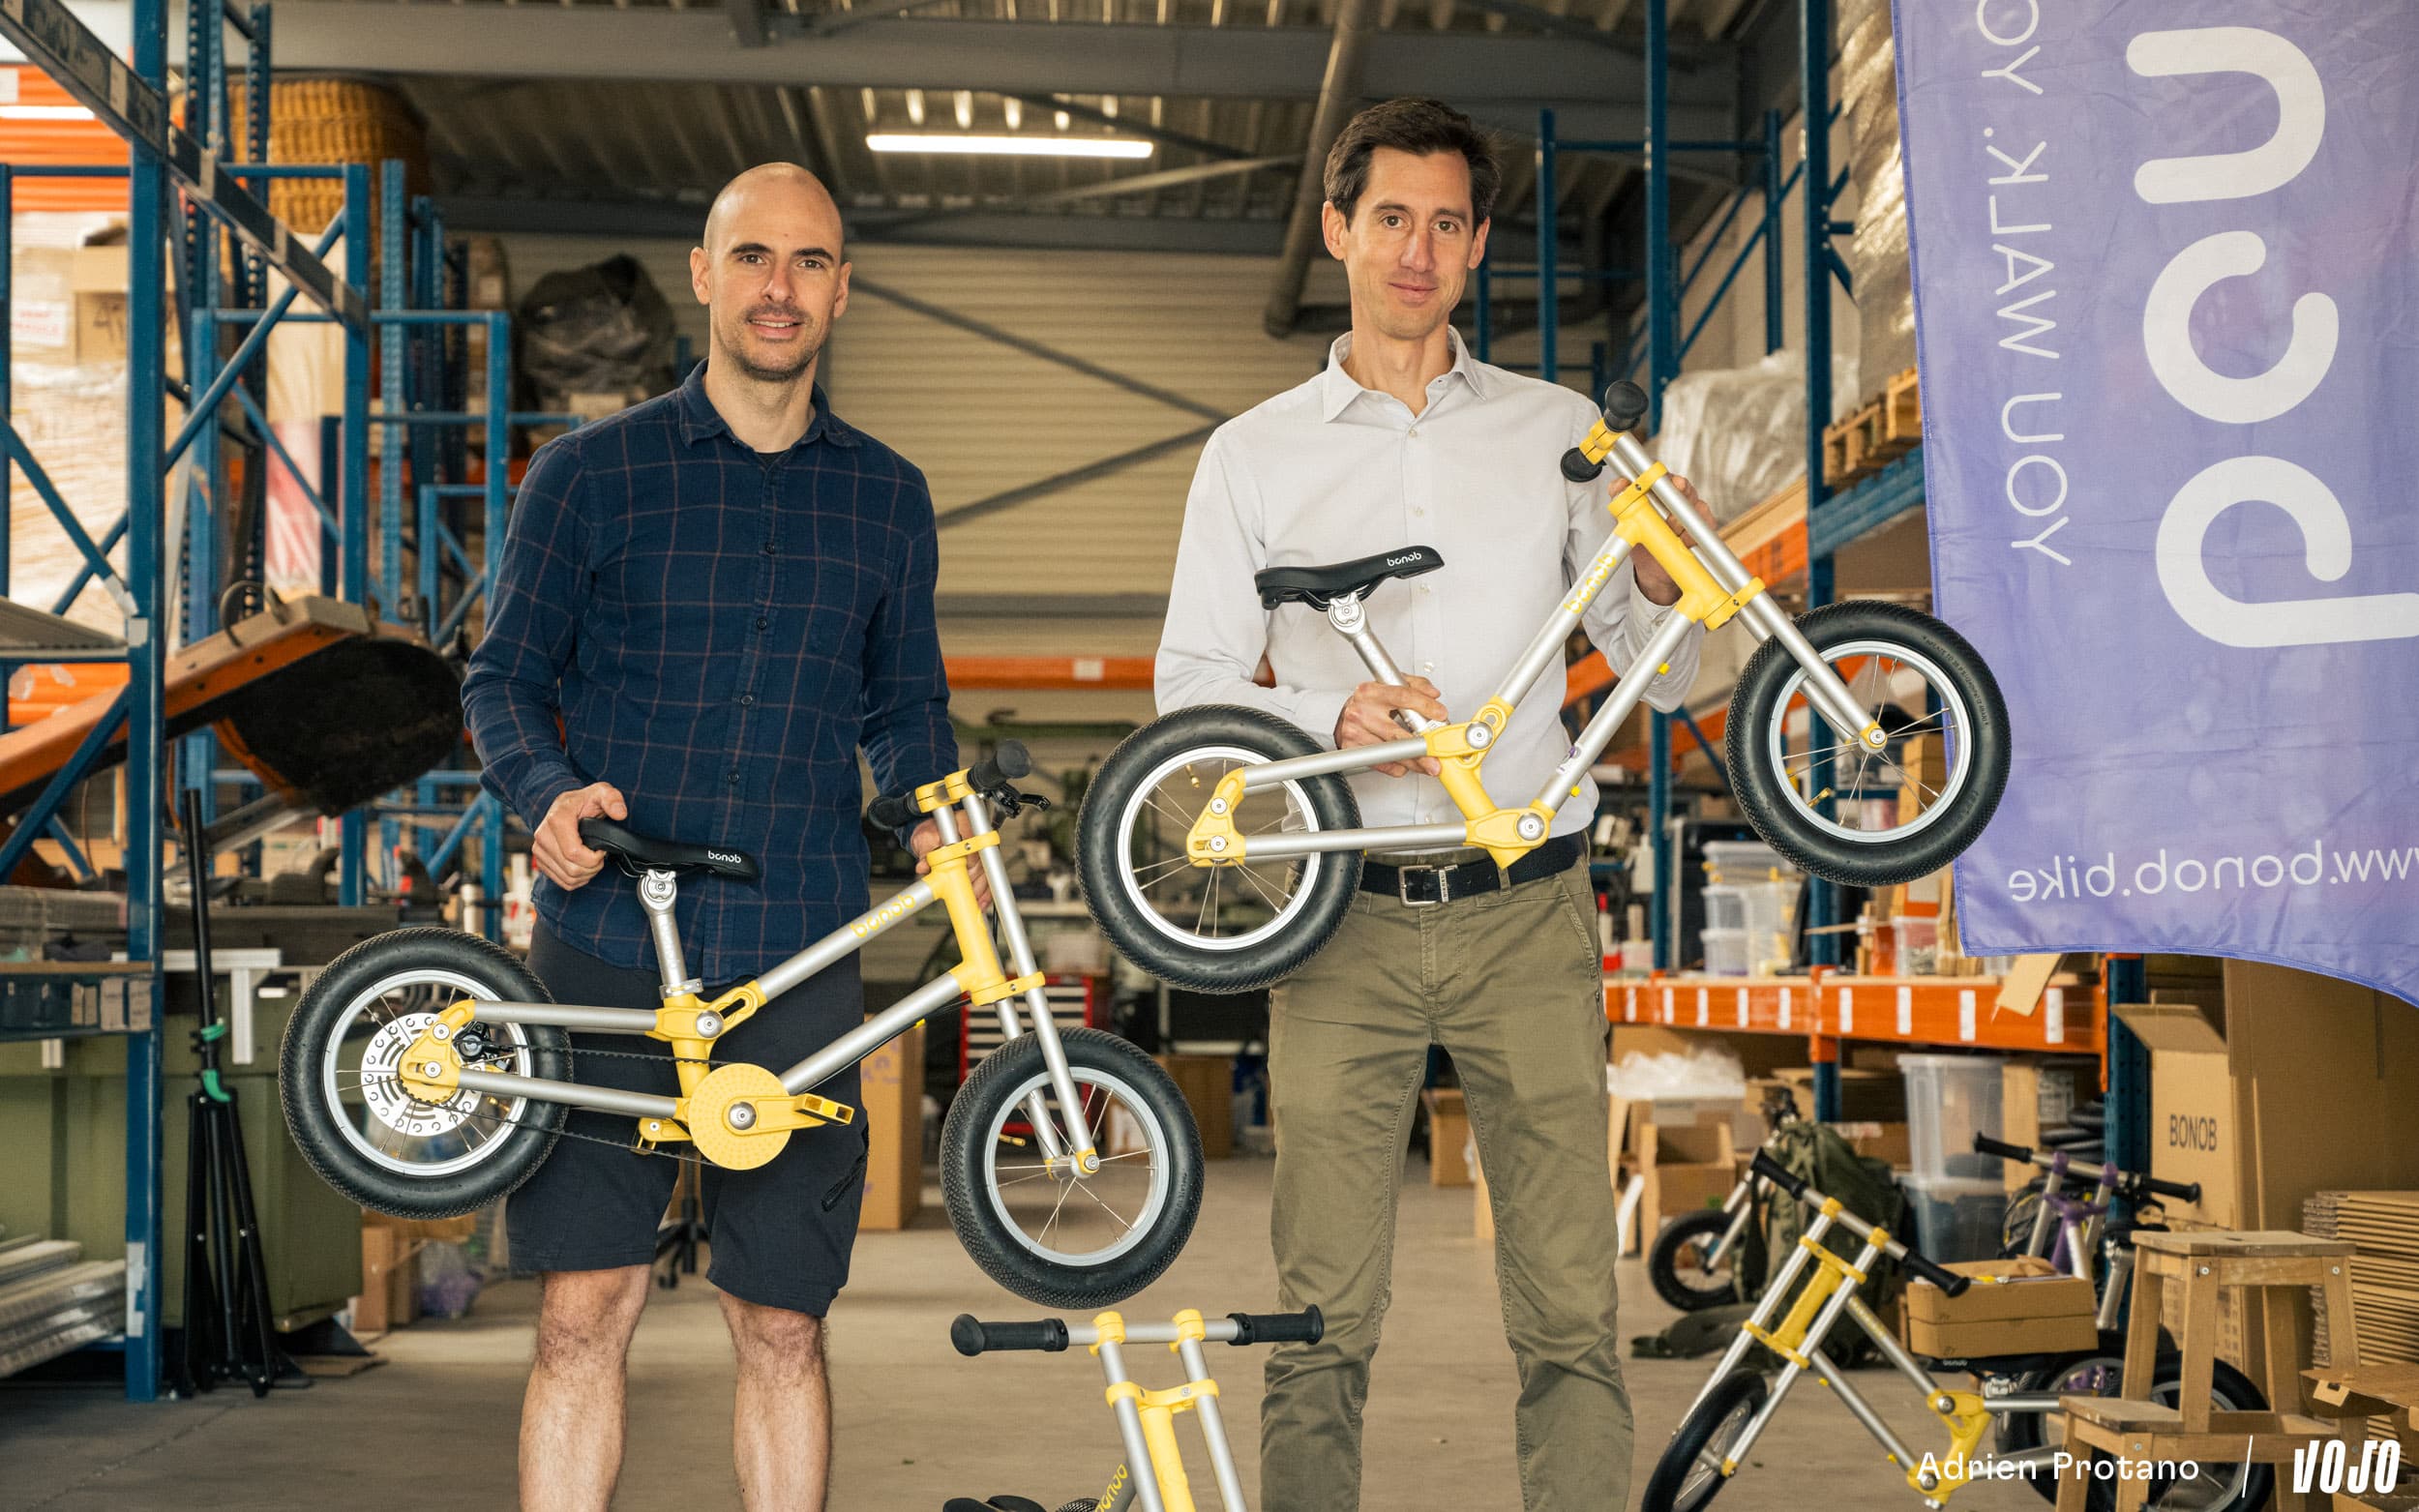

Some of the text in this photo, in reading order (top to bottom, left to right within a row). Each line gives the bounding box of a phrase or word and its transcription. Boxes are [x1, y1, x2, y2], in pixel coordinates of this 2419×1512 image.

[1387, 551, 1422, 567] bonob
[1563, 553, 1618, 614] bonob
[707, 849, 742, 864] bonob
[850, 894, 916, 938] bonob
[2169, 1114, 2218, 1152] BONOB
